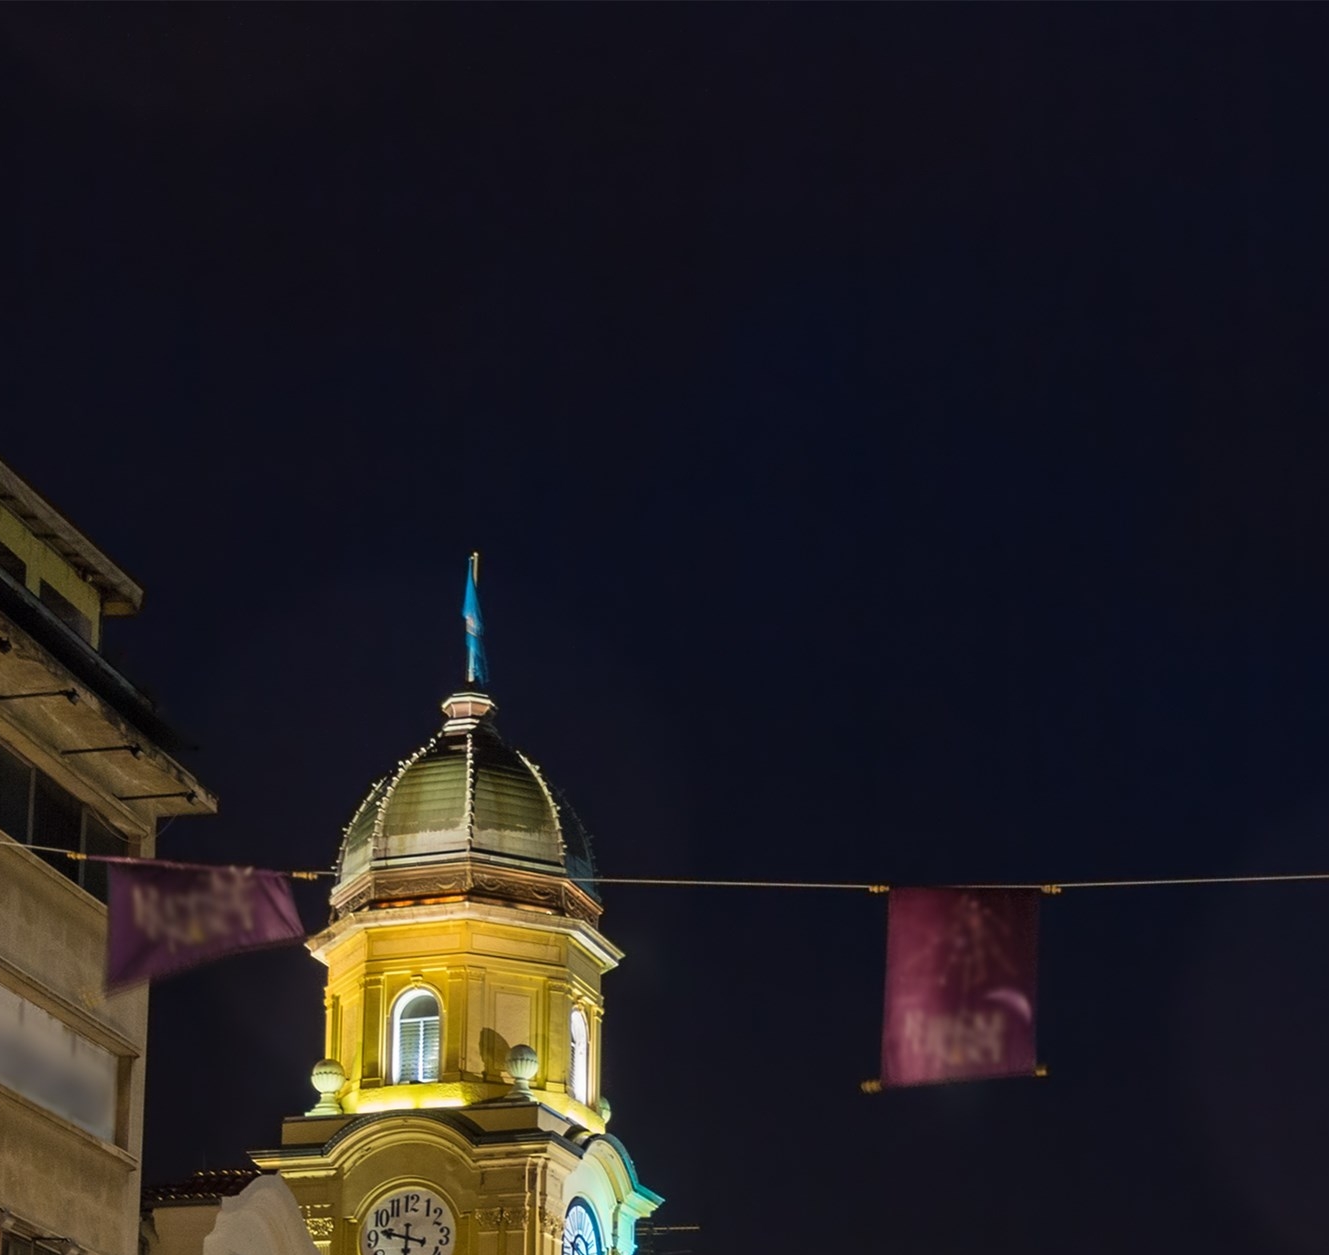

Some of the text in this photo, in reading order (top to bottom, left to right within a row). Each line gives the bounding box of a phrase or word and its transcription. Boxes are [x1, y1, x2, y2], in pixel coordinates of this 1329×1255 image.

[389, 1198, 400, 1218] 11
[404, 1194, 420, 1213] 12
[424, 1198, 431, 1217] 1
[374, 1209, 390, 1228] 10
[433, 1207, 443, 1226] 2
[367, 1230, 379, 1249] 9
[439, 1226, 450, 1246] 3
